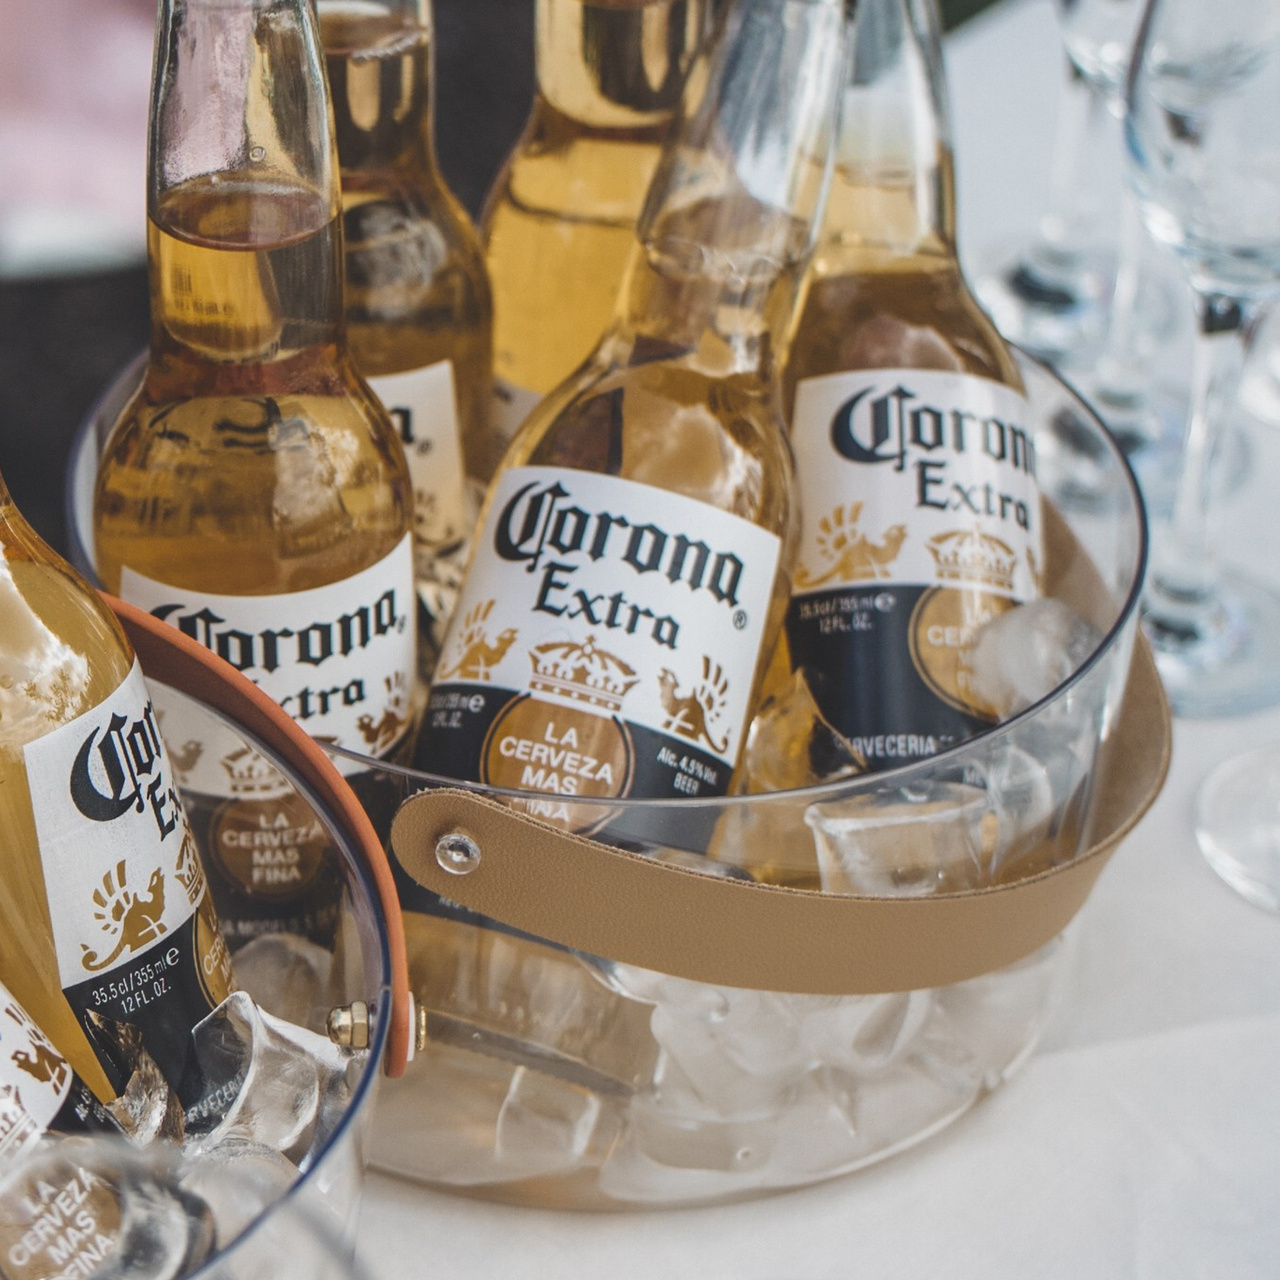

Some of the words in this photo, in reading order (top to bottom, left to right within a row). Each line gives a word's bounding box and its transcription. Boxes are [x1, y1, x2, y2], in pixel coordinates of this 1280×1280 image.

[915, 459, 1029, 532] Extra
[493, 480, 745, 608] Corona
[531, 561, 680, 651] Extra
[544, 721, 579, 749] LA
[498, 735, 614, 786] CERVEZA
[520, 765, 578, 797] MAS
[221, 819, 329, 849] CERVEZA
[258, 812, 289, 829] LA
[251, 847, 300, 867] MAS
[251, 867, 301, 884] FINA
[8, 1166, 97, 1266] CERVEZA
[22, 1179, 58, 1216] LA
[45, 1209, 97, 1266] MAS
